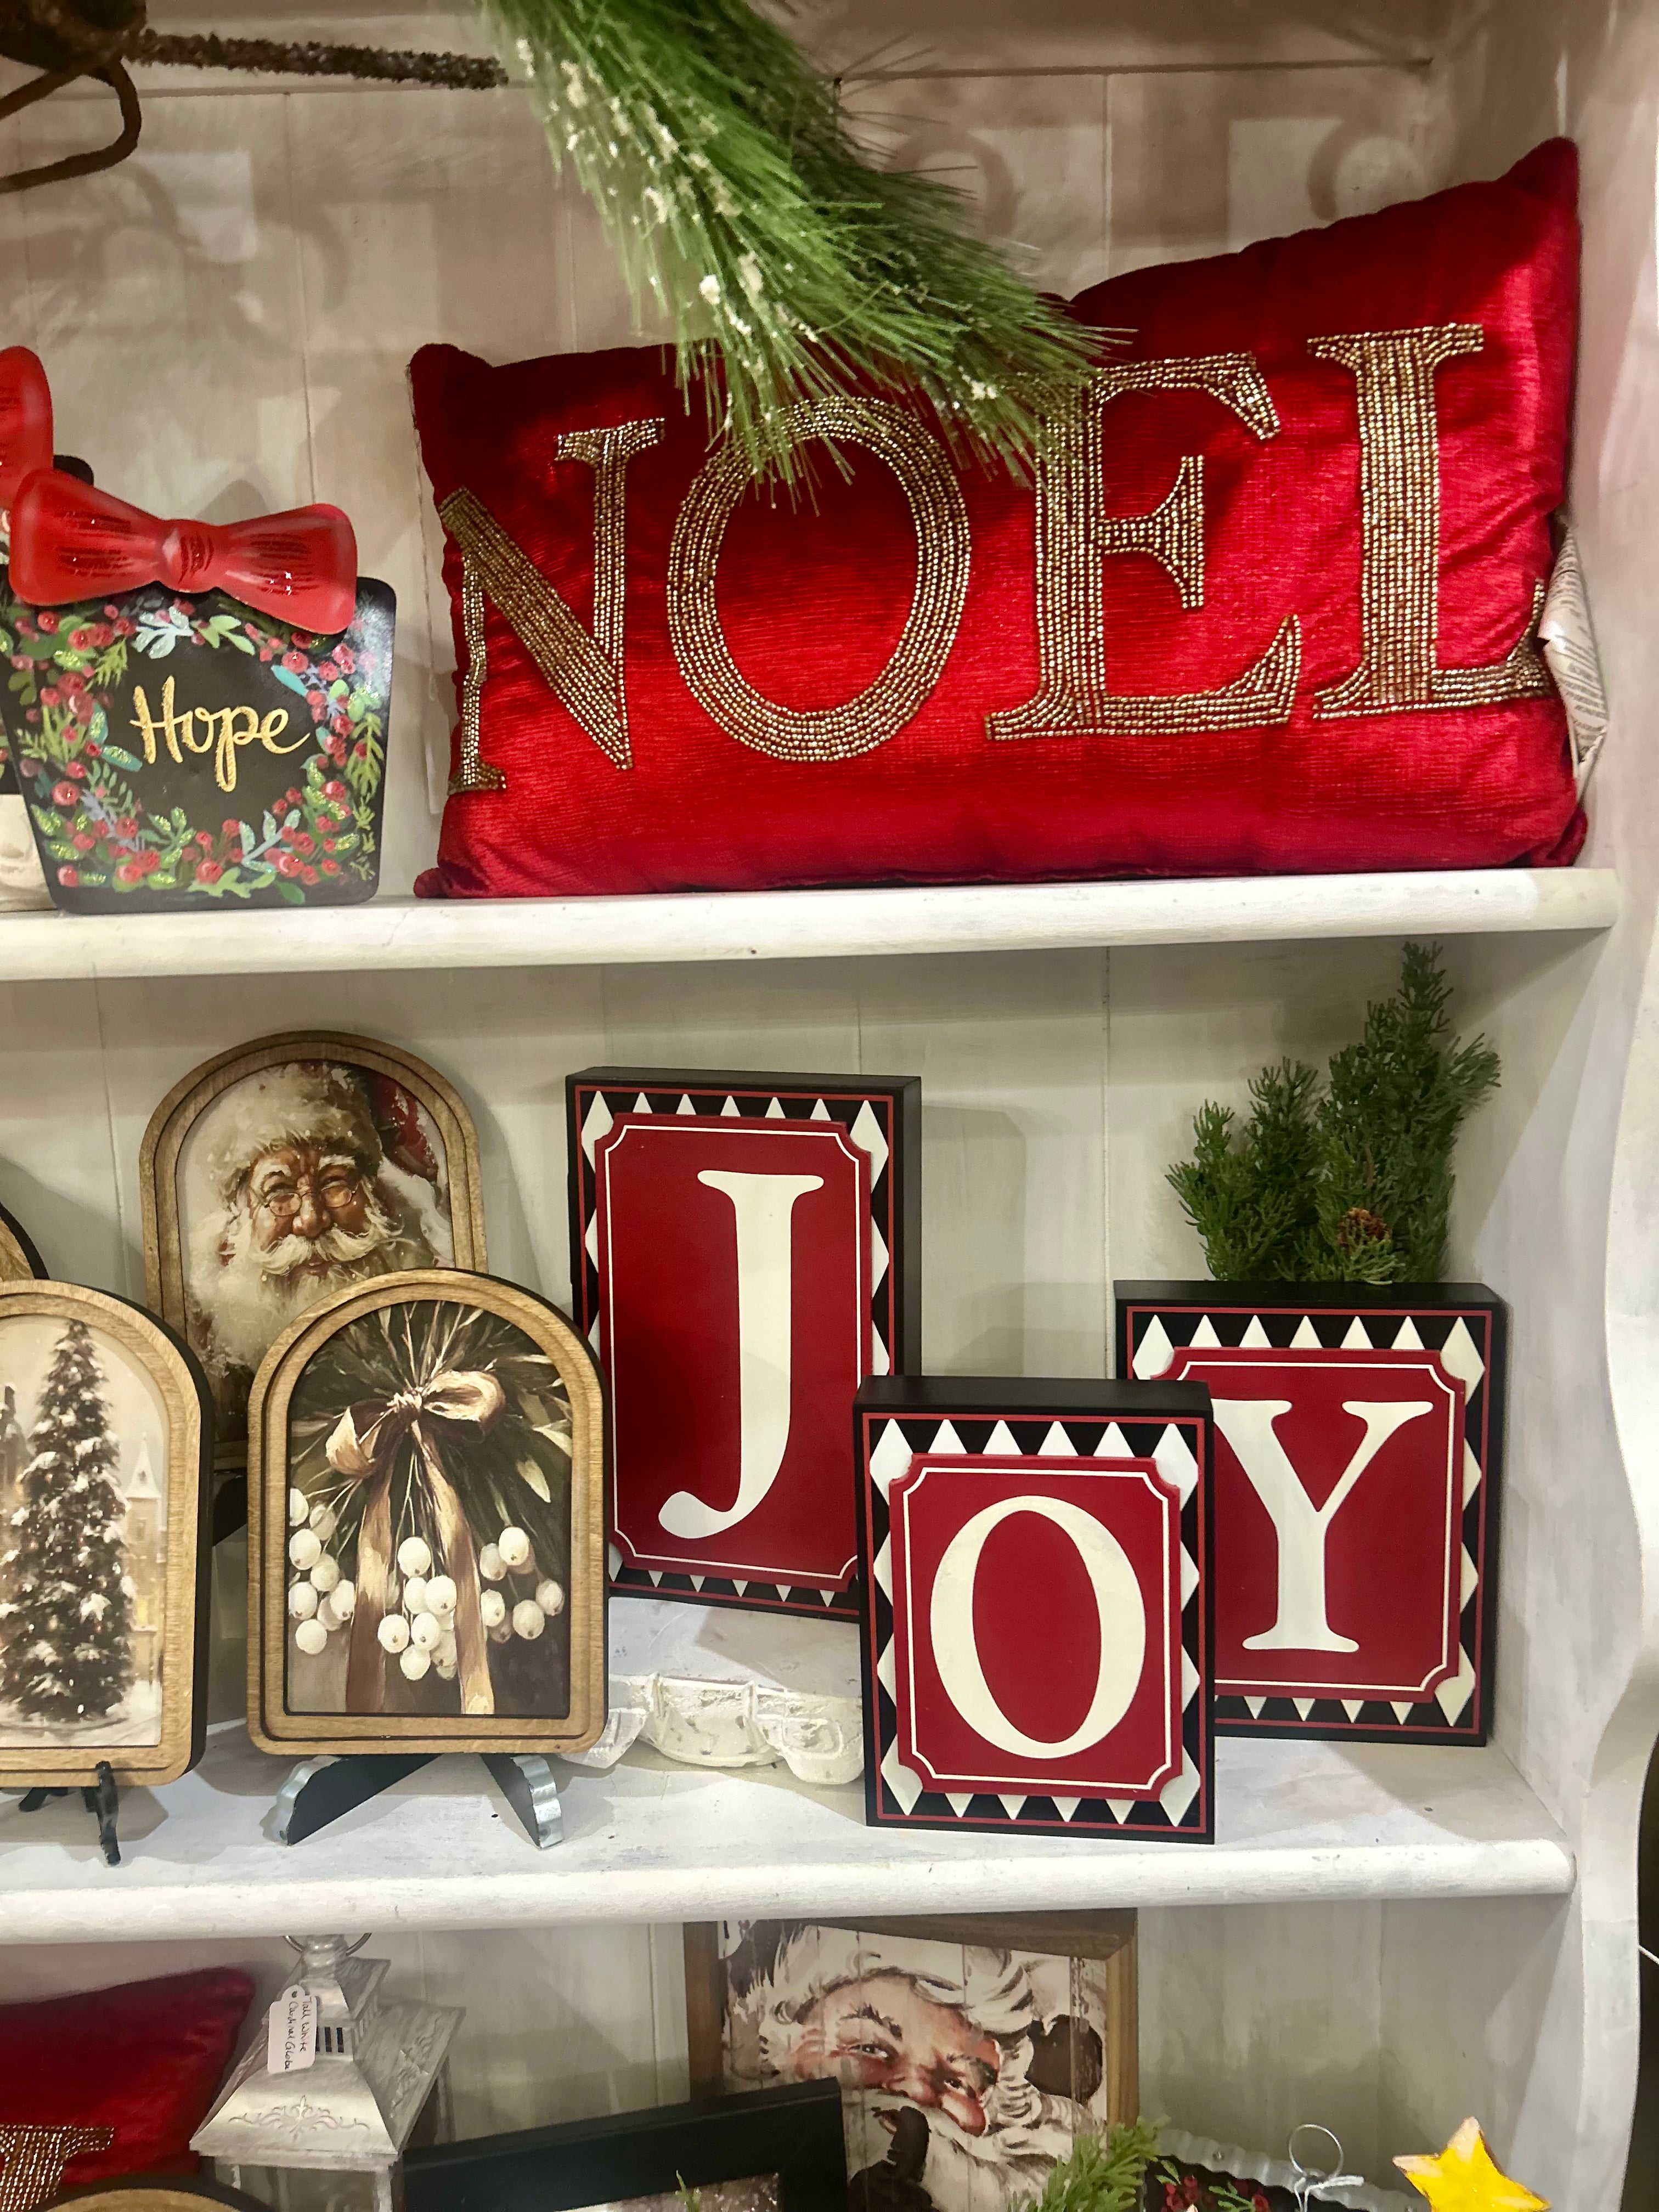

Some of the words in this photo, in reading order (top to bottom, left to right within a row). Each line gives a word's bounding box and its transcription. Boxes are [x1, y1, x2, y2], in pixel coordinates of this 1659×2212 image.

[440, 323, 1550, 794] NOEL
[129, 675, 311, 792] Hope
[658, 1169, 824, 1539] J
[1210, 1398, 1434, 1652] Y
[929, 1495, 1146, 1759] O
[287, 2001, 298, 2039] Cardinal
[300, 2022, 309, 2052] White
[301, 1995, 312, 2019] Tall
